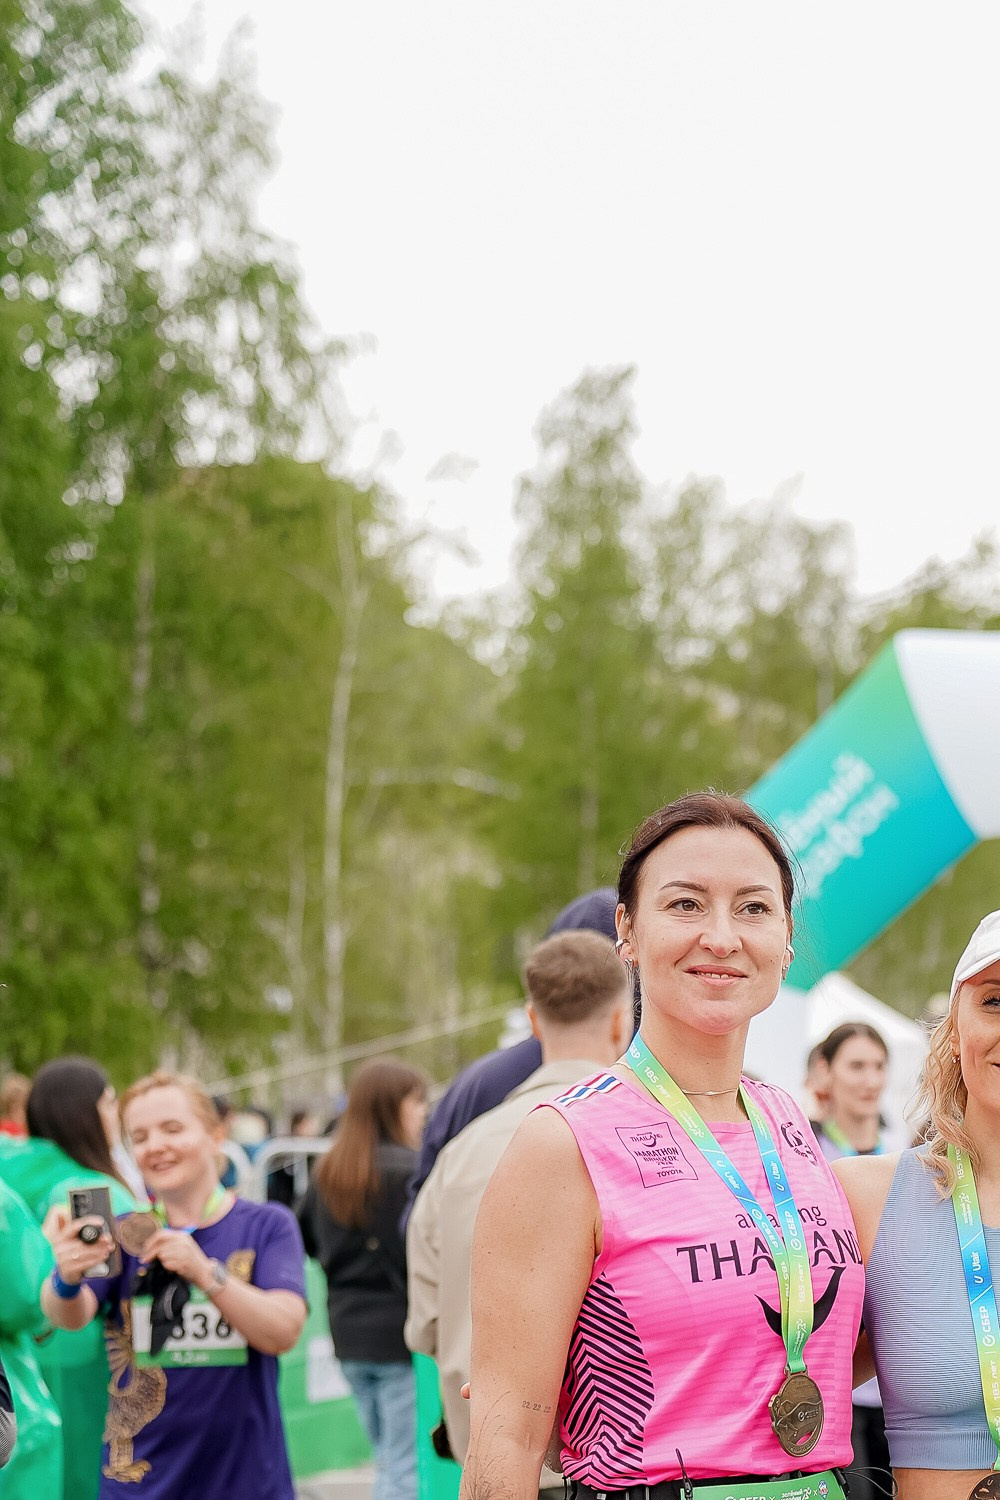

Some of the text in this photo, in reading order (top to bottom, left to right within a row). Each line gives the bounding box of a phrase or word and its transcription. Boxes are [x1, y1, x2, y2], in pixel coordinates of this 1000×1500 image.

[643, 1066, 659, 1084] 185
[634, 1147, 680, 1157] MARATHON
[657, 1169, 684, 1178] TOYOTA
[956, 1163, 965, 1180] 185
[735, 1205, 827, 1229] aang
[784, 1210, 798, 1237] СБЕР
[761, 1221, 779, 1249] СБЕР
[676, 1229, 863, 1283] THAAND
[979, 1305, 992, 1333] СБЕР
[991, 1380, 1000, 1401] 185
